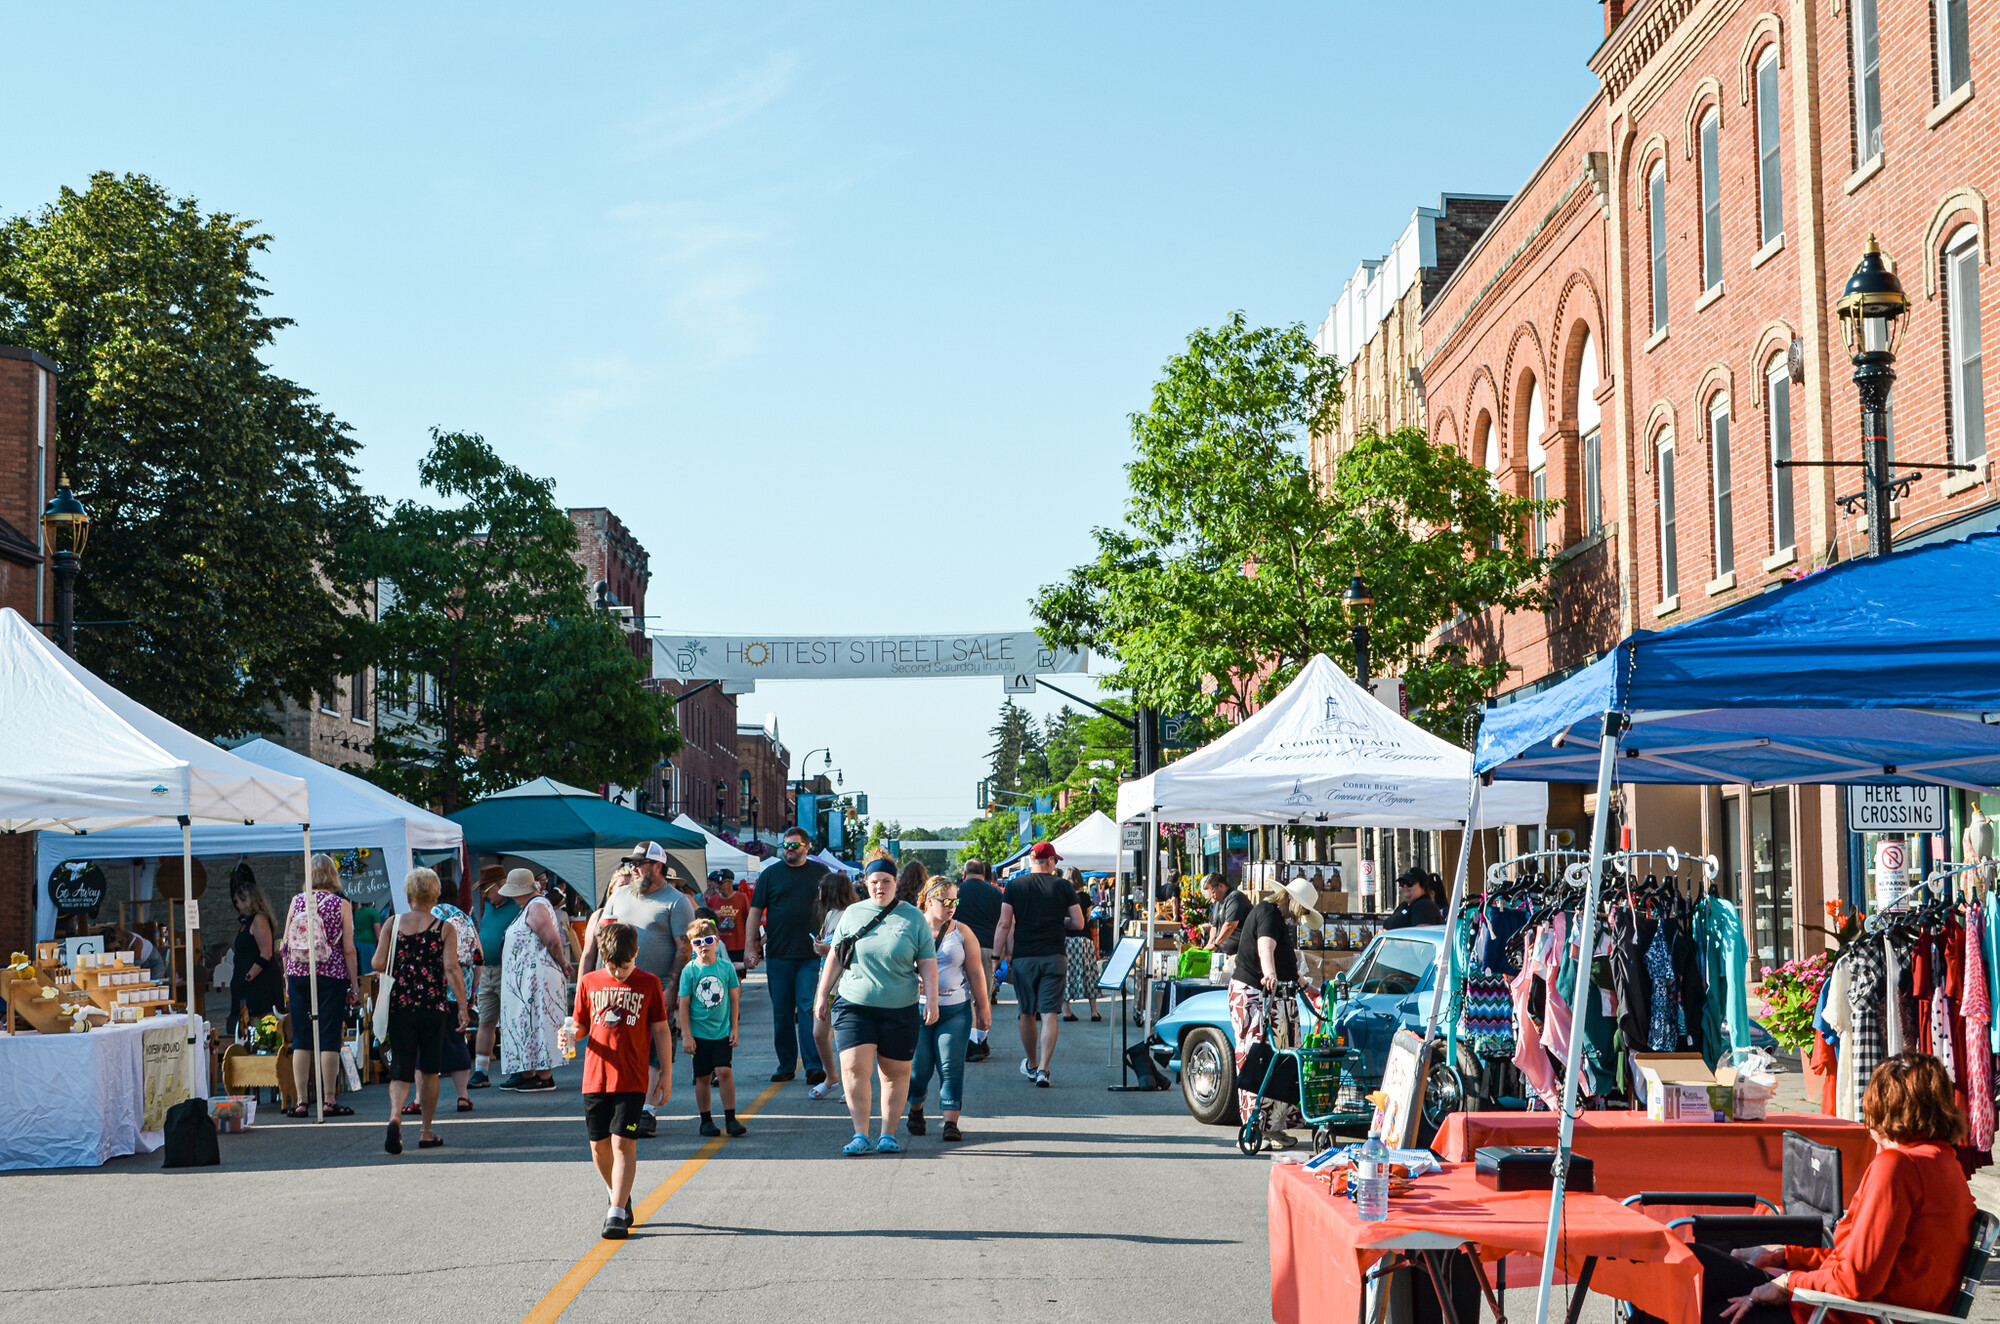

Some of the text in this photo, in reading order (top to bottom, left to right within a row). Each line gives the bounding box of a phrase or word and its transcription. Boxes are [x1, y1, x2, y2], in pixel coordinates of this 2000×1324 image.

[726, 637, 1015, 666] HOTTEST STREET SALE
[891, 660, 1016, 674] Second Saturday in July
[1280, 737, 1401, 749] COBBLE BEACH
[1342, 781, 1399, 791] COBBLE BEACH
[1865, 786, 1927, 803] HERE TO
[1860, 805, 1933, 823] CROSSING
[55, 882, 70, 899] Go
[71, 882, 101, 906] Away
[590, 990, 645, 1018] CONVERSE
[626, 1014, 637, 1026] 08
